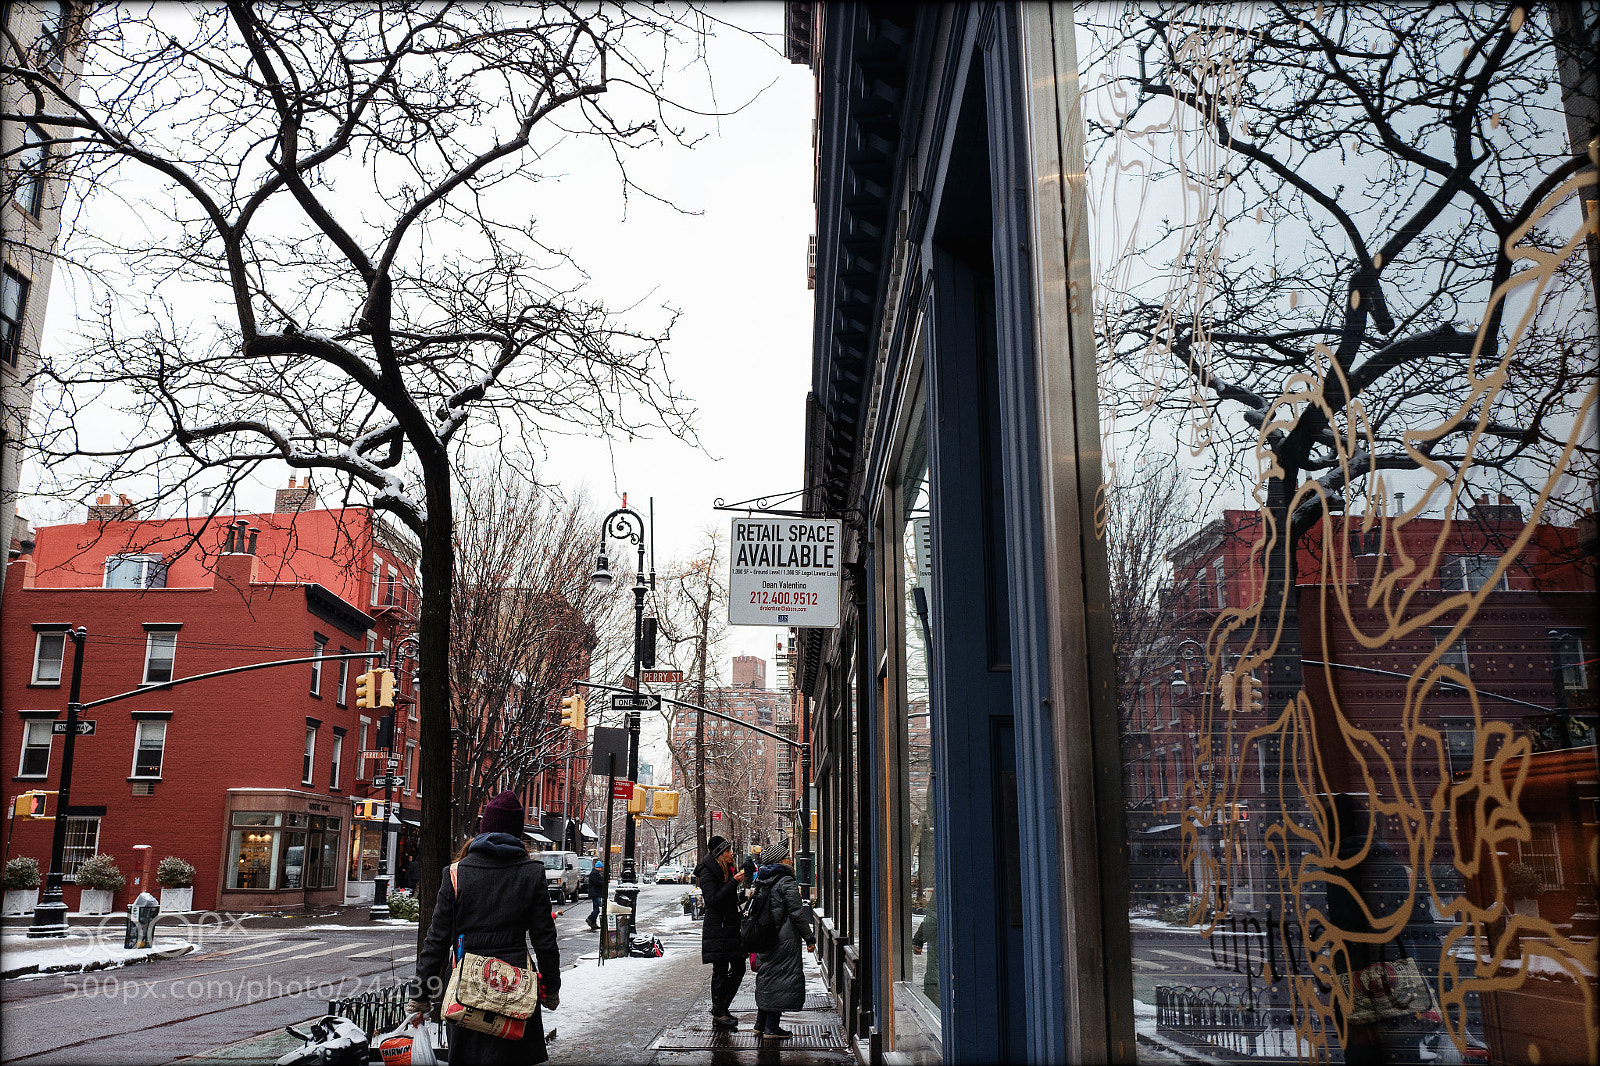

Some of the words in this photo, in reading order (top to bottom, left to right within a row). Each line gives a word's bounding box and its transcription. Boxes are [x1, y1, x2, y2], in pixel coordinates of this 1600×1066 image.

[737, 524, 784, 541] RETAIL
[789, 525, 834, 542] SPACE
[736, 544, 834, 568] AVAILABLE
[762, 581, 777, 589] Dean
[779, 581, 807, 589] Valentino
[750, 591, 818, 605] 212.400.9512
[644, 672, 667, 682] PERRY
[671, 673, 681, 682] ST
[363, 751, 378, 759] PERRY
